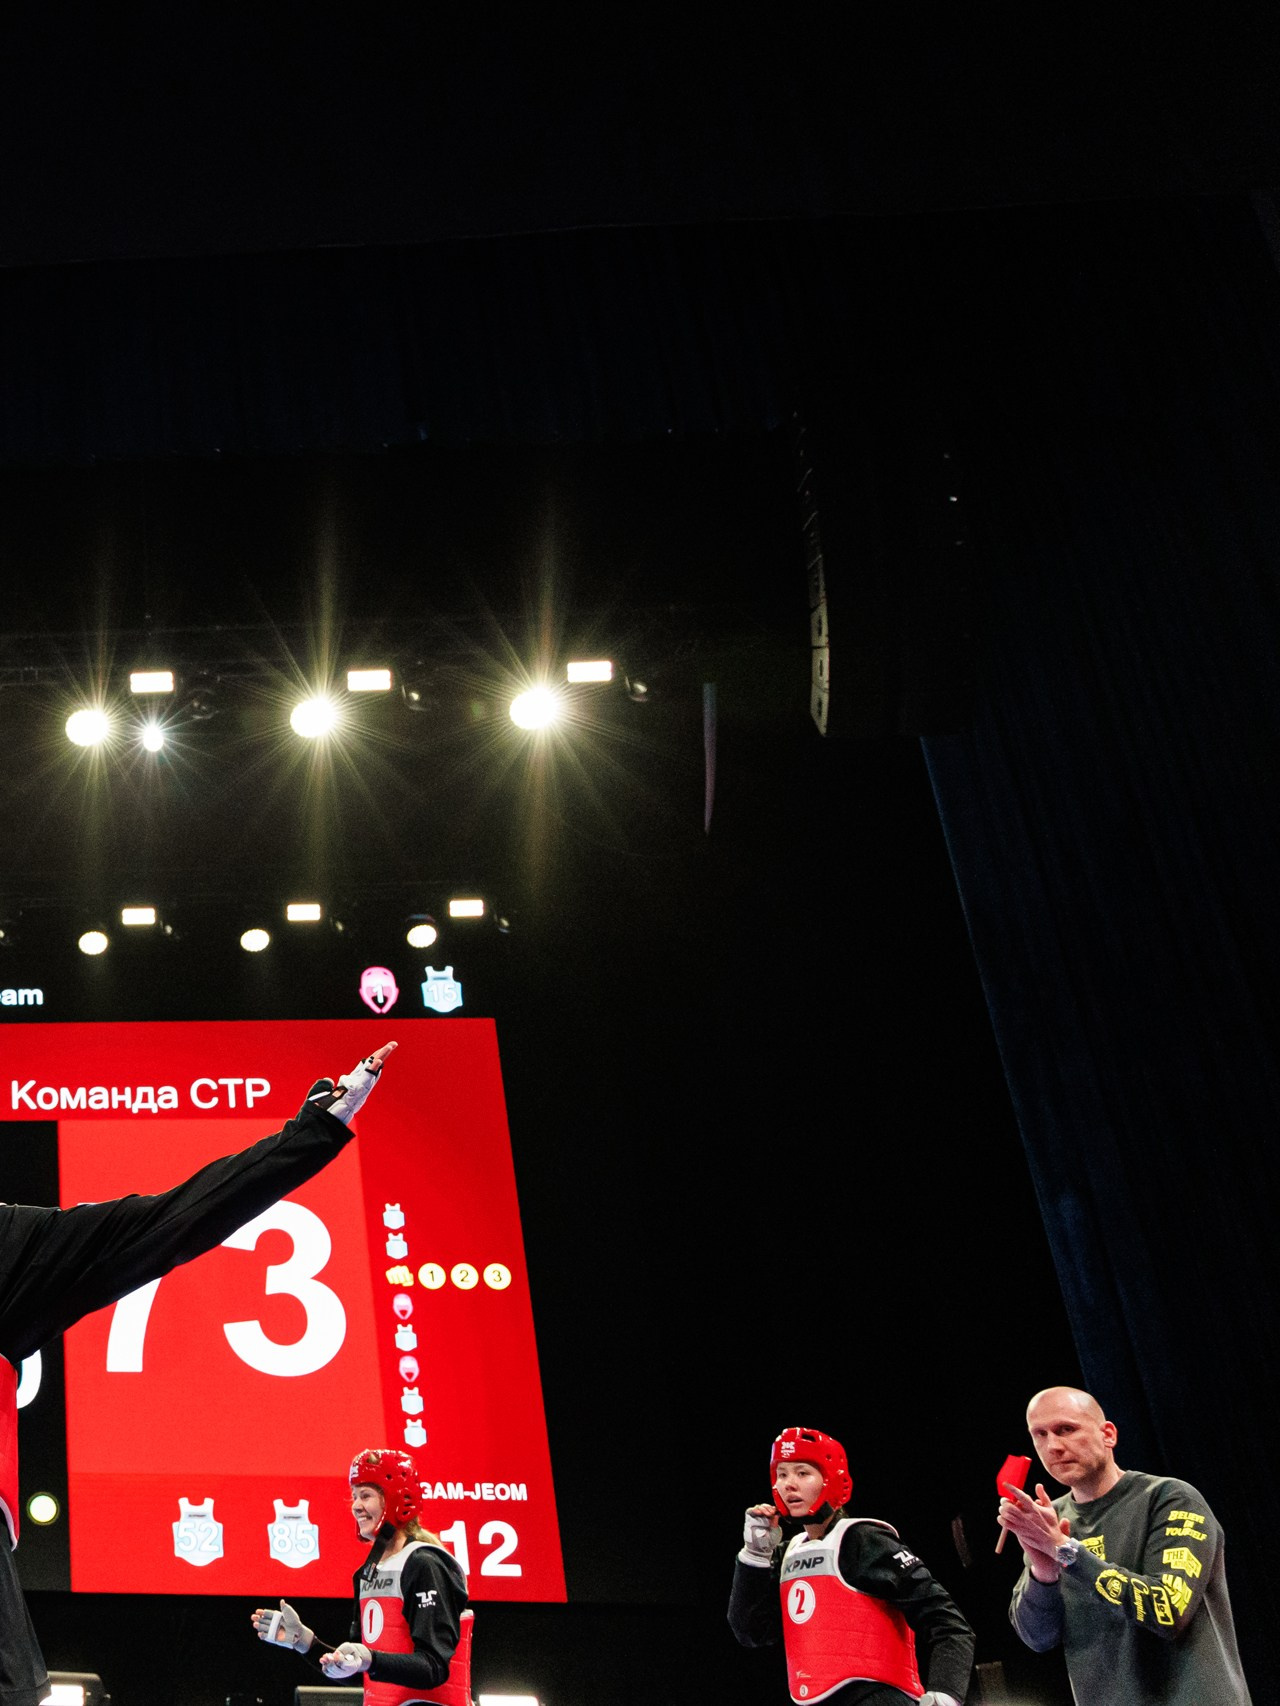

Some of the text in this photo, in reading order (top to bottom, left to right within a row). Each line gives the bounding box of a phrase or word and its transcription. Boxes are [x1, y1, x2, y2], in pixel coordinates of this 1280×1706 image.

[11, 1078, 271, 1114] Команда СТР
[419, 1482, 528, 1501] GAM-JEOM
[177, 1521, 220, 1553] 52
[272, 1522, 317, 1554] 85
[439, 1520, 523, 1577] 12
[784, 1556, 824, 1574] KPNP
[1166, 1549, 1185, 1561] THE
[362, 1579, 394, 1592] KPNP
